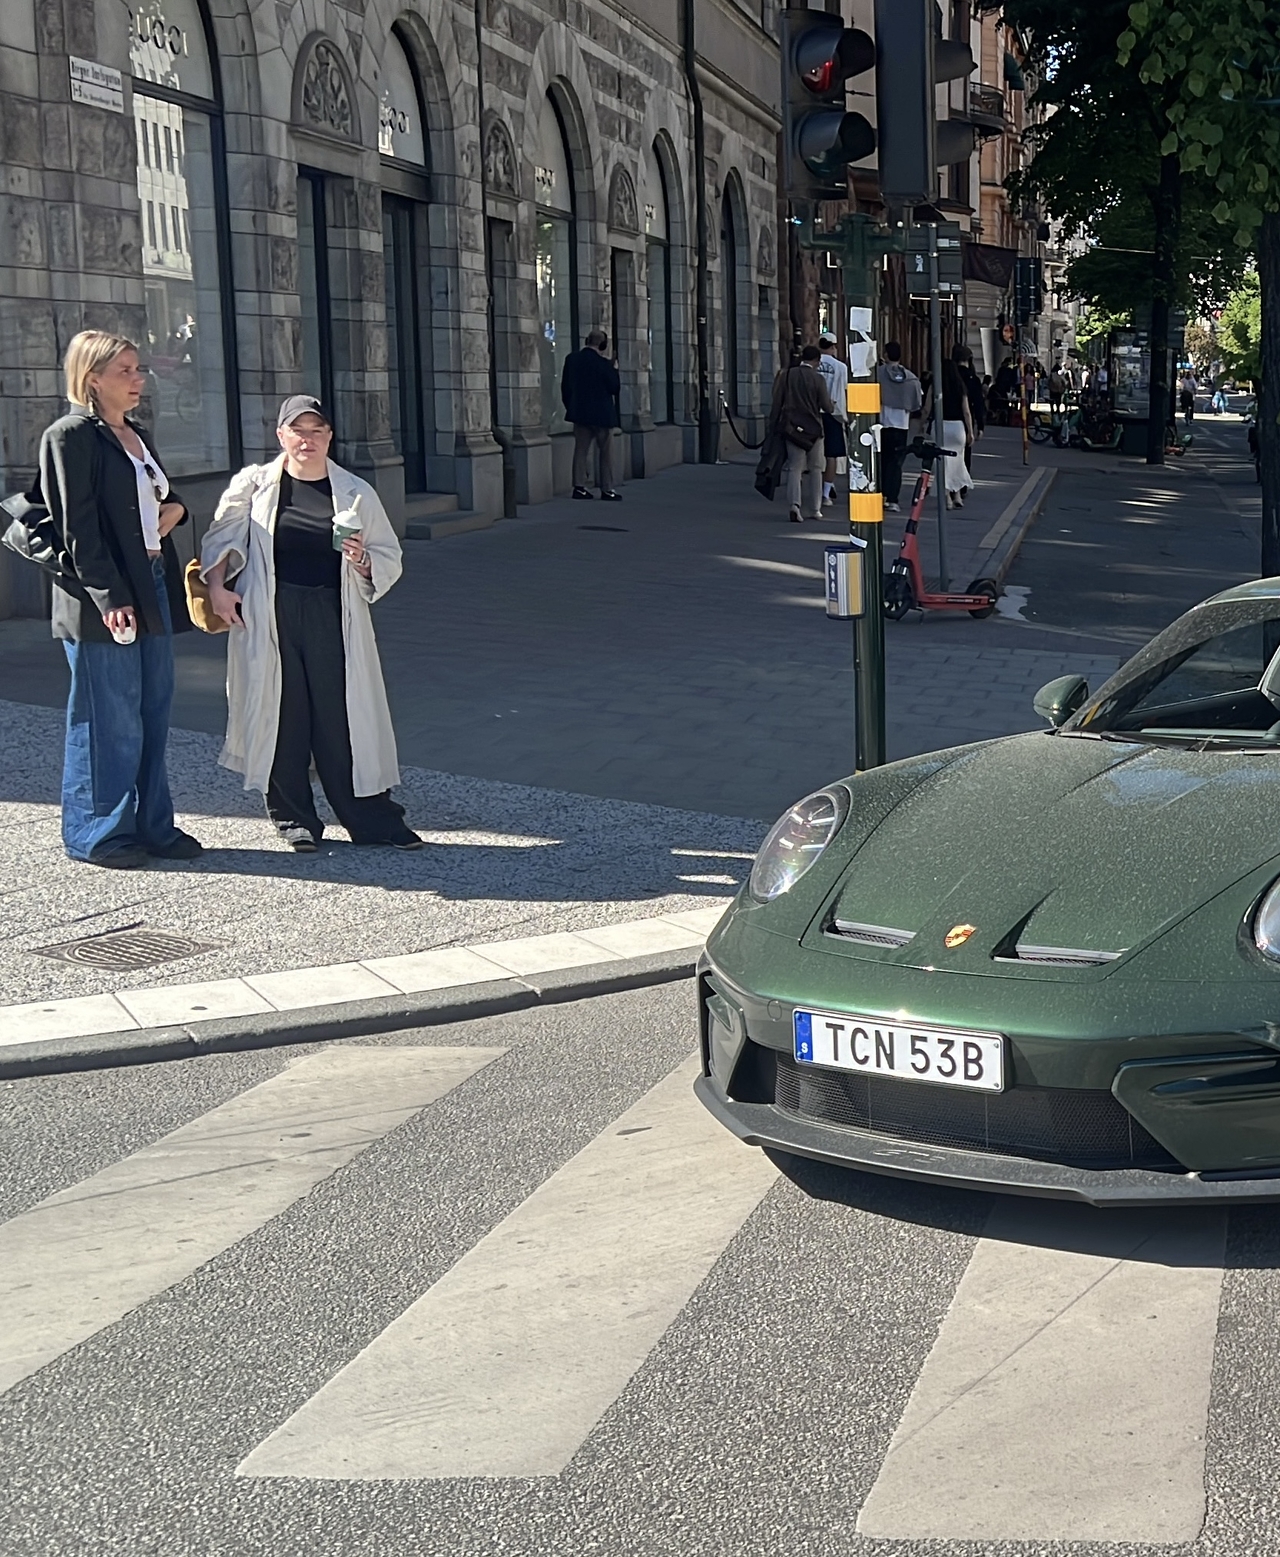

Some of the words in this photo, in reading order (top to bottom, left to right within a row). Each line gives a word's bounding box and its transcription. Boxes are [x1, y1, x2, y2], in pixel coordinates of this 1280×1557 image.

[801, 1042, 809, 1054] S
[825, 1022, 895, 1070] TCN
[910, 1034, 985, 1081] 53B
